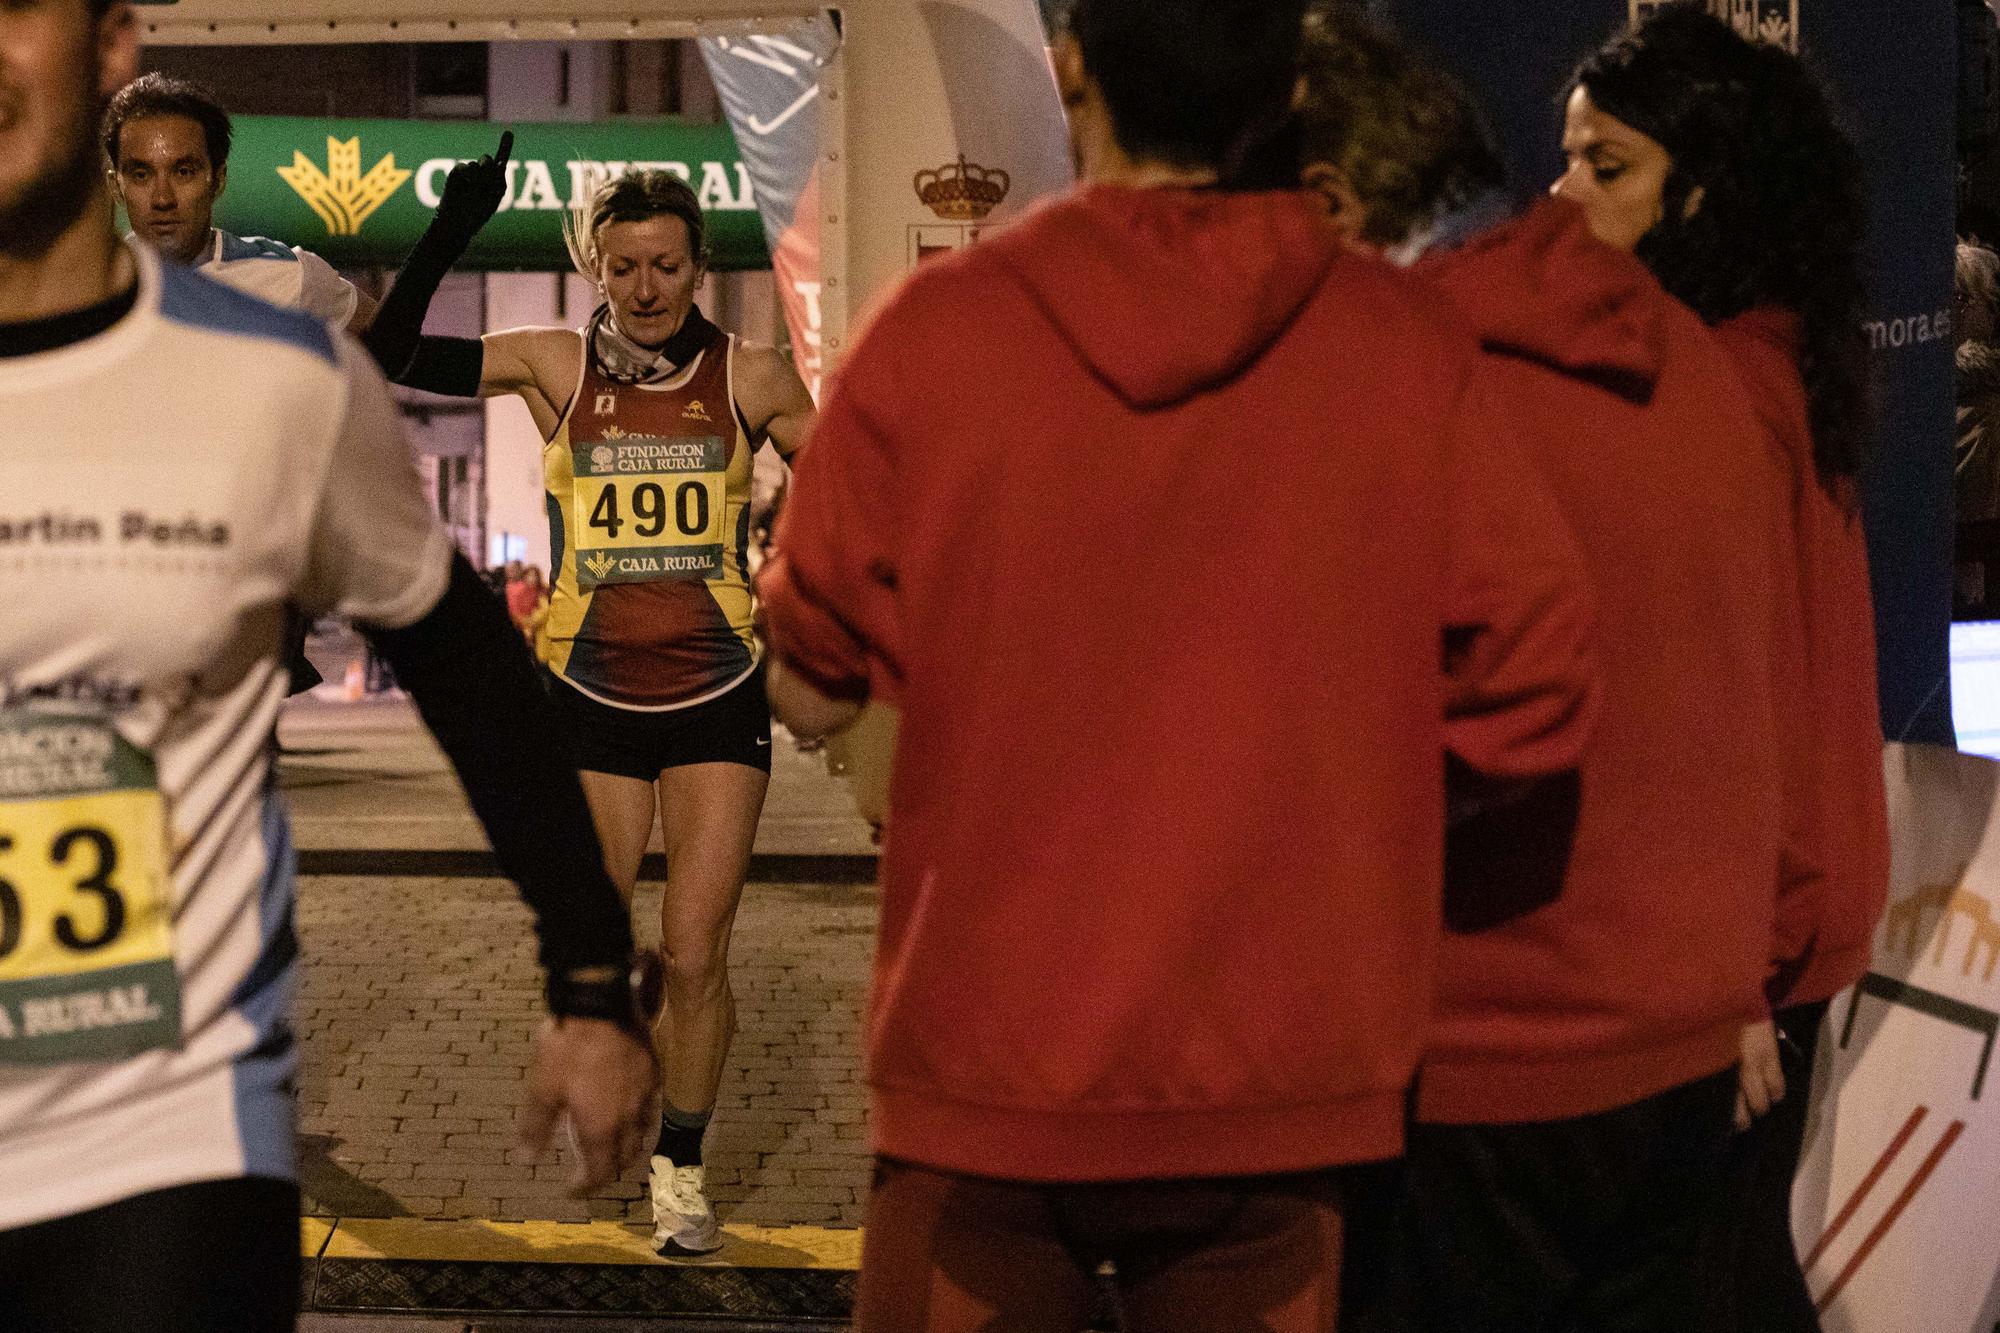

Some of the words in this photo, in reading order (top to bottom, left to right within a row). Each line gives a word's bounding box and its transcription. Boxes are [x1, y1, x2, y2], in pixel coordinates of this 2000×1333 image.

[617, 444, 704, 459] FUNDACION
[618, 459, 652, 472] CAJA
[657, 458, 705, 471] RURAL
[589, 481, 709, 538] 490
[618, 557, 660, 572] CAJA
[663, 555, 715, 570] RURAL
